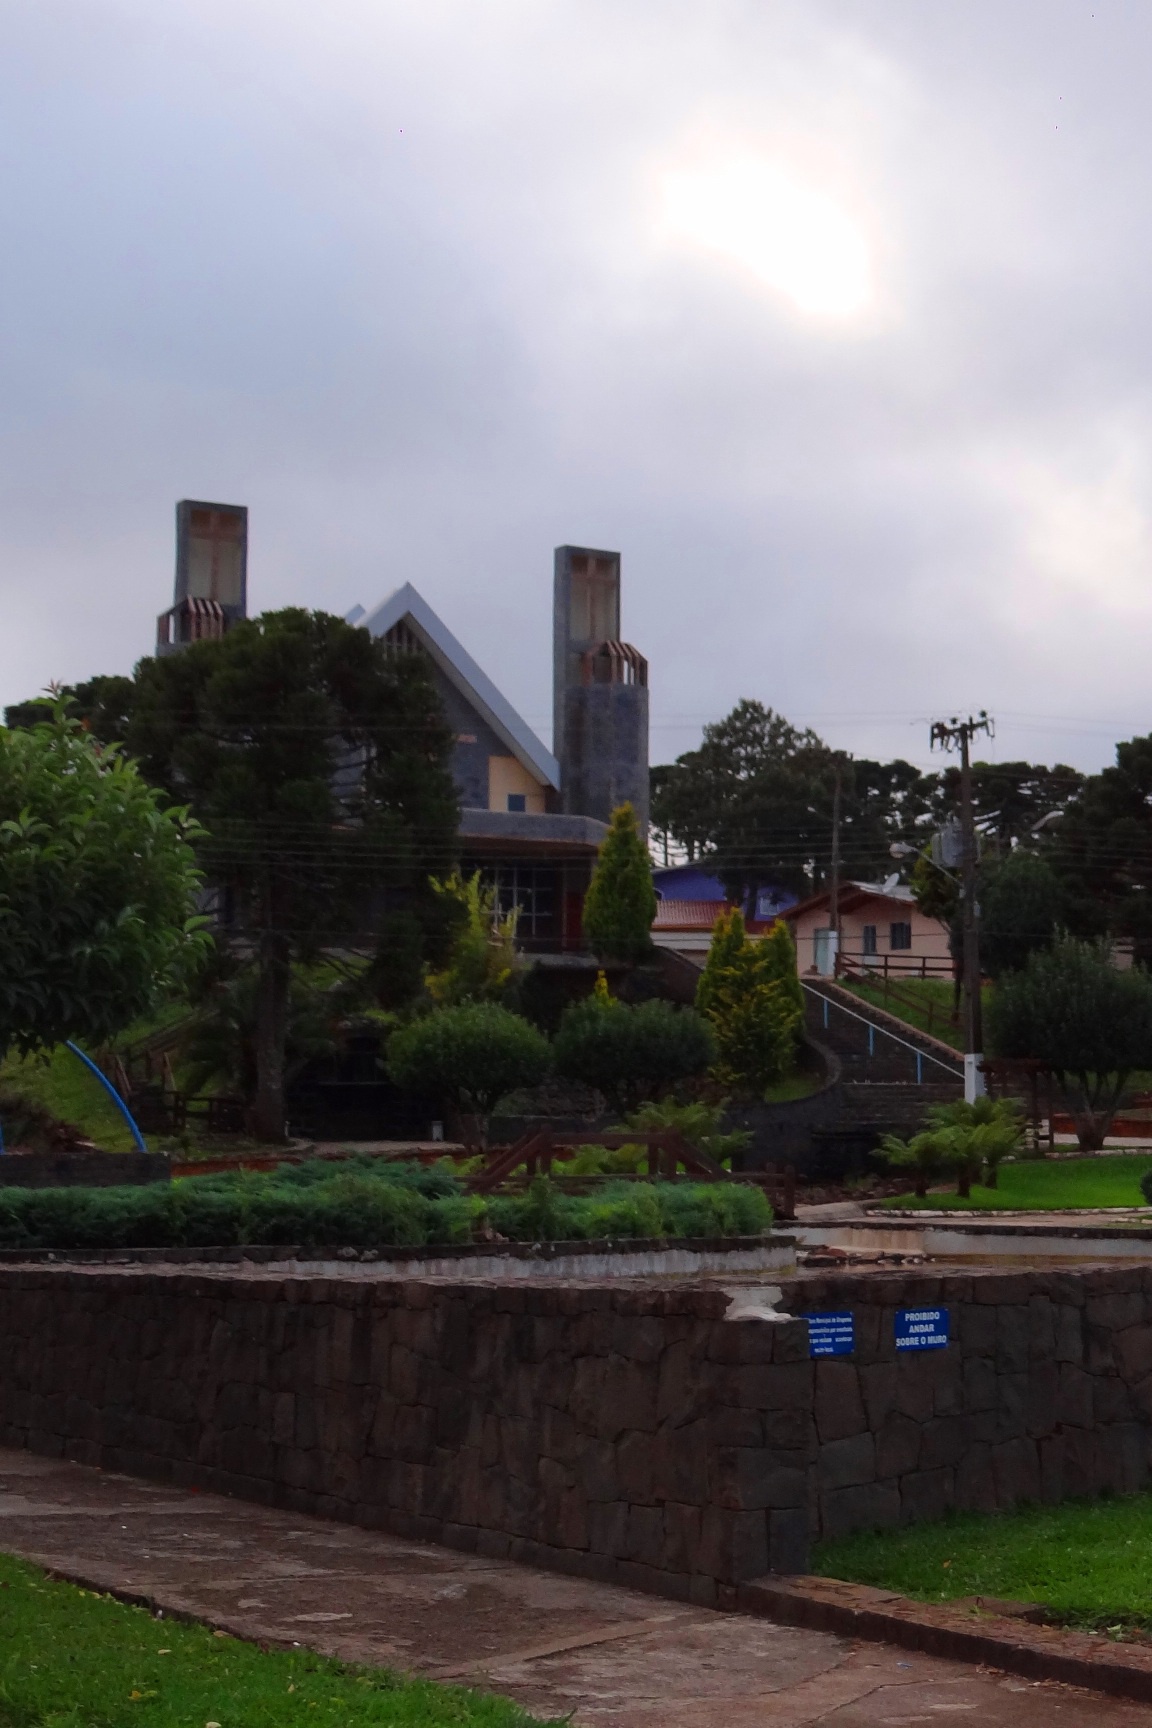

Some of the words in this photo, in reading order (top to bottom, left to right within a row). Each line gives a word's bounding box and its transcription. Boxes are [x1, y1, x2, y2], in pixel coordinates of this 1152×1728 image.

[905, 1311, 940, 1322] PROIBIDO
[908, 1323, 935, 1334] ANDAR
[895, 1336, 919, 1347] SOBRE
[920, 1335, 926, 1345] O
[927, 1334, 947, 1344] MURO
